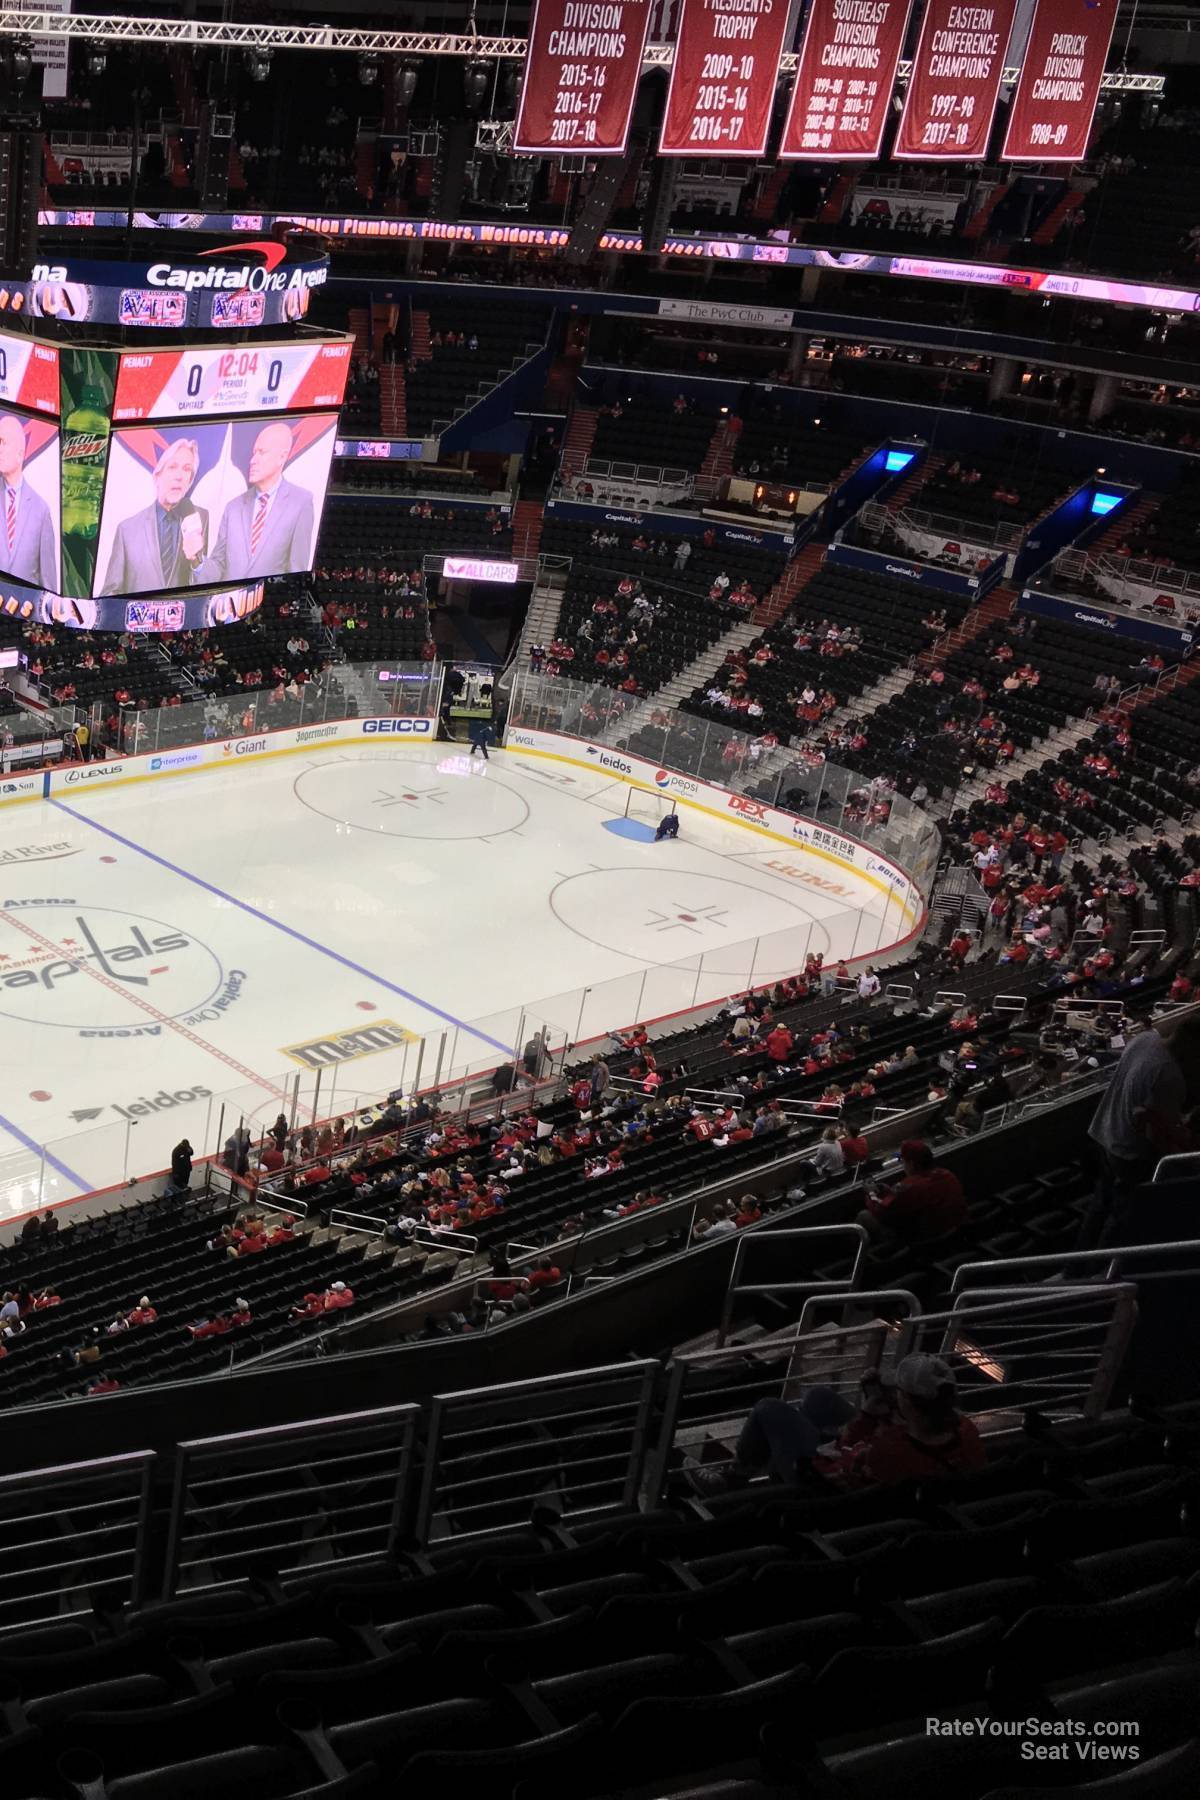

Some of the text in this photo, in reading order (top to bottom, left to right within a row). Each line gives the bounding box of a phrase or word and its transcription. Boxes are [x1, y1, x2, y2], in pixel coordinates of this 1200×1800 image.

[563, 3, 623, 29] DIVISION
[832, 0, 890, 24] SOUTHEAST
[947, 6, 995, 31] EASTERN
[713, 15, 758, 40] TROPHY
[833, 22, 879, 47] DIVISION
[548, 31, 626, 58] CHAMPIONS
[931, 30, 1000, 55] CONFERENCE
[1050, 33, 1088, 56] PATRICK
[702, 54, 754, 80] 2009-10
[821, 46, 881, 69] CHAMPIONS
[928, 54, 991, 79] CHAMPIONS
[1044, 57, 1084, 79] DIVISION
[559, 64, 606, 87] 2015-16
[695, 85, 748, 111] 2015-16
[1032, 79, 1084, 102] CHAMPIONS
[554, 92, 601, 114] 2016-17
[930, 95, 975, 118] 1997-98
[550, 119, 596, 141] 2017-18
[690, 116, 743, 141] 2016-17
[922, 122, 969, 145] 2017-18
[1029, 124, 1068, 146] 1988-89
[146, 264, 327, 292] Capital One Arena
[688, 305, 708, 317] The
[738, 309, 764, 321] Club
[122, 356, 153, 368] PENALTY
[321, 346, 349, 357] PENALTY
[218, 353, 258, 378] 12:04
[267, 360, 282, 391] 0
[187, 364, 202, 397] 0
[178, 400, 204, 410] CAPITALS
[485, 565, 516, 580] CAPS
[362, 719, 430, 733] GEICO
[235, 738, 266, 755] Giant
[515, 735, 536, 747] WGL
[80, 765, 123, 779] LEXUS
[599, 752, 632, 774] leidos
[18, 781, 34, 792] Son
[670, 776, 699, 793] pepsi
[727, 796, 769, 820] DEX
[736, 810, 769, 828] imaging
[18, 841, 72, 860] River
[877, 864, 906, 888] BOEING
[2, 897, 77, 908] Arena
[79, 968, 247, 1039] Capital One Arena
[110, 1082, 213, 1120] leidos
